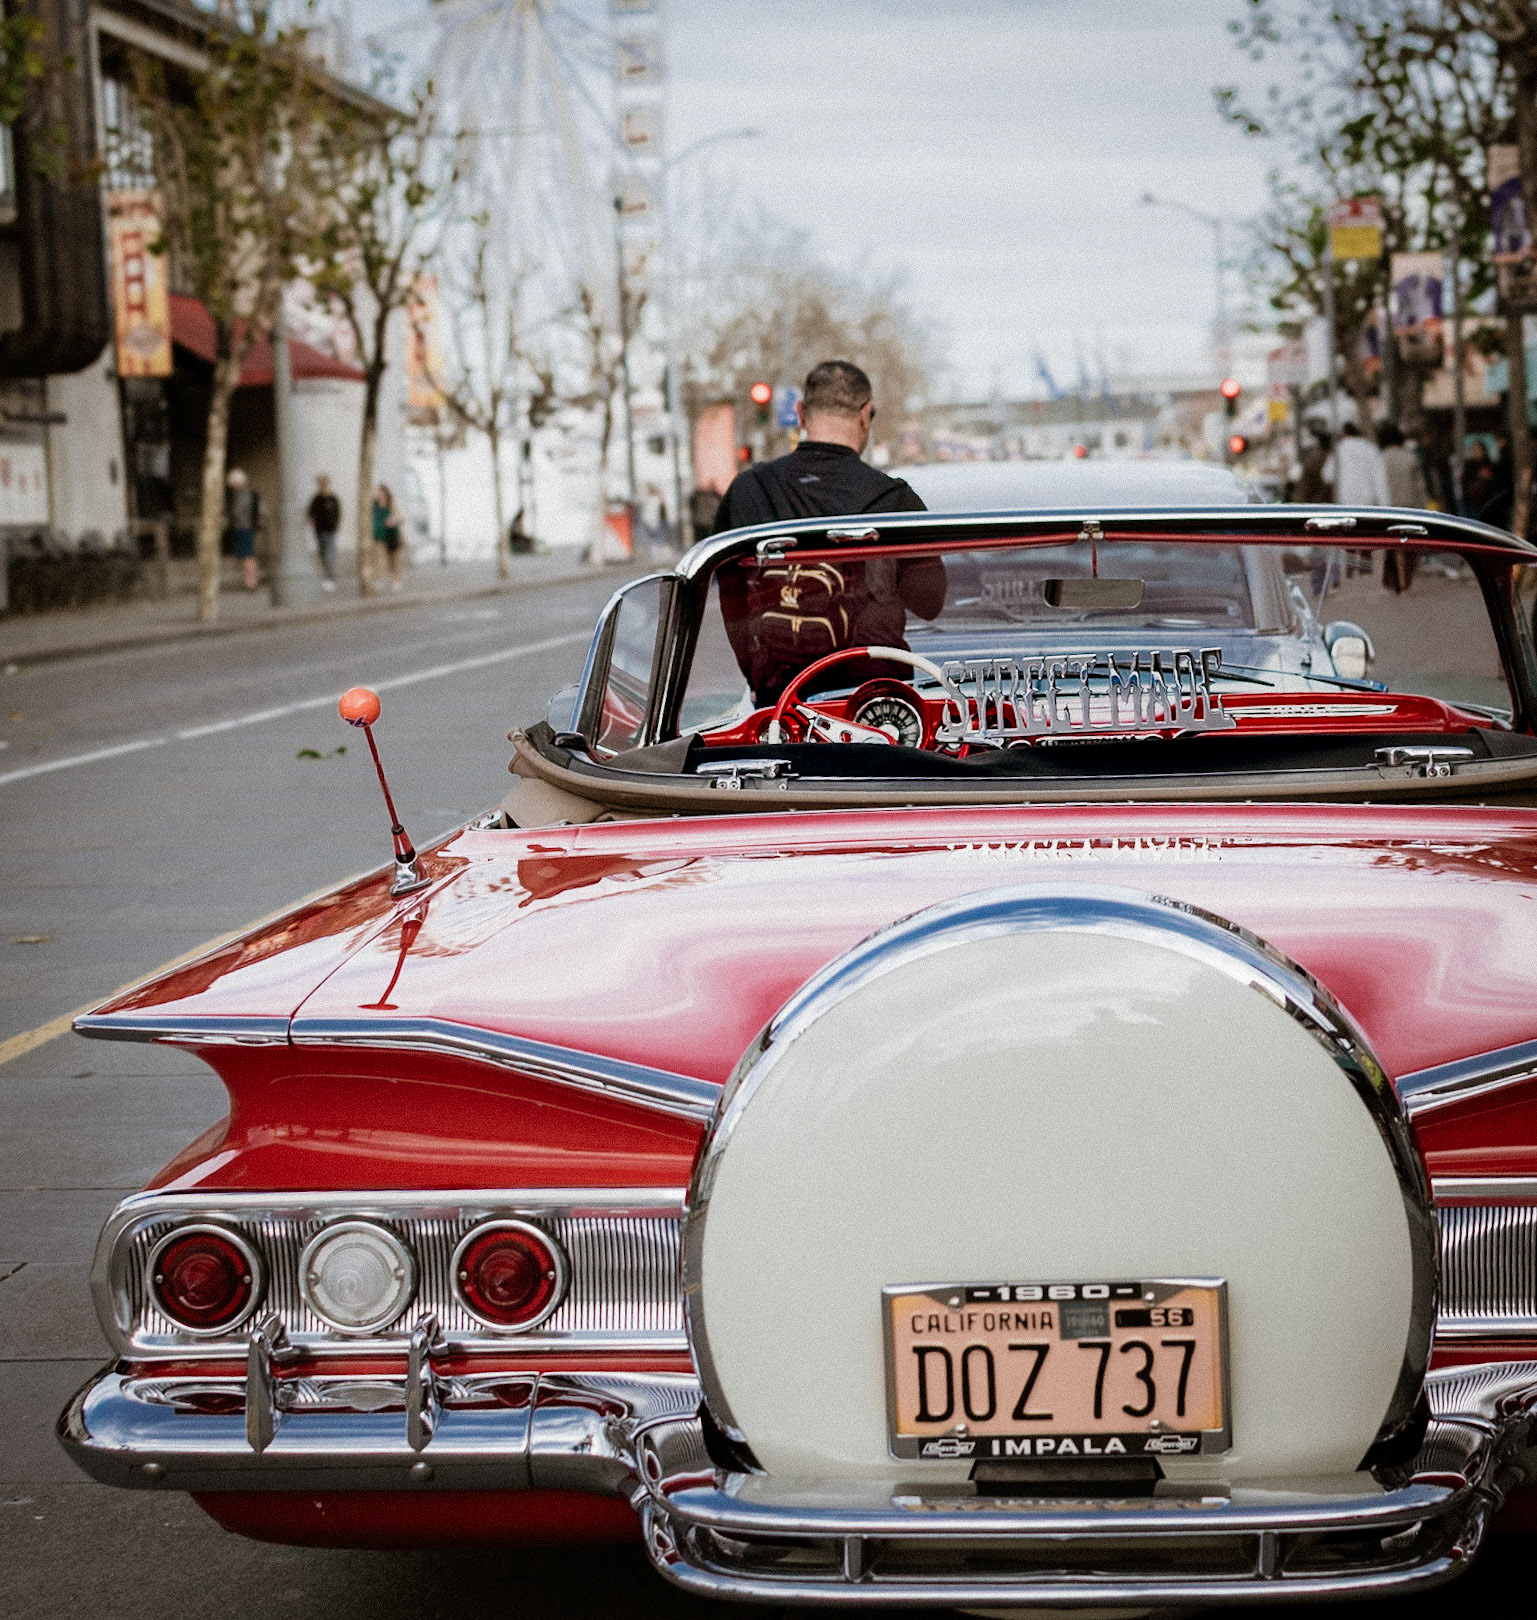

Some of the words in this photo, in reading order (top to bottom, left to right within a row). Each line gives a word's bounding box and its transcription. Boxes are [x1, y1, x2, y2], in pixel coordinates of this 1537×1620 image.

[938, 653, 1097, 741] STREET
[1106, 647, 1236, 731] MADE
[910, 1311, 1054, 1335] CALIFORNIA
[1149, 1308, 1185, 1327] 56
[911, 1342, 1054, 1423] DOZ
[1077, 1339, 1196, 1419] 737
[991, 1436, 1127, 1456] IMPALA
